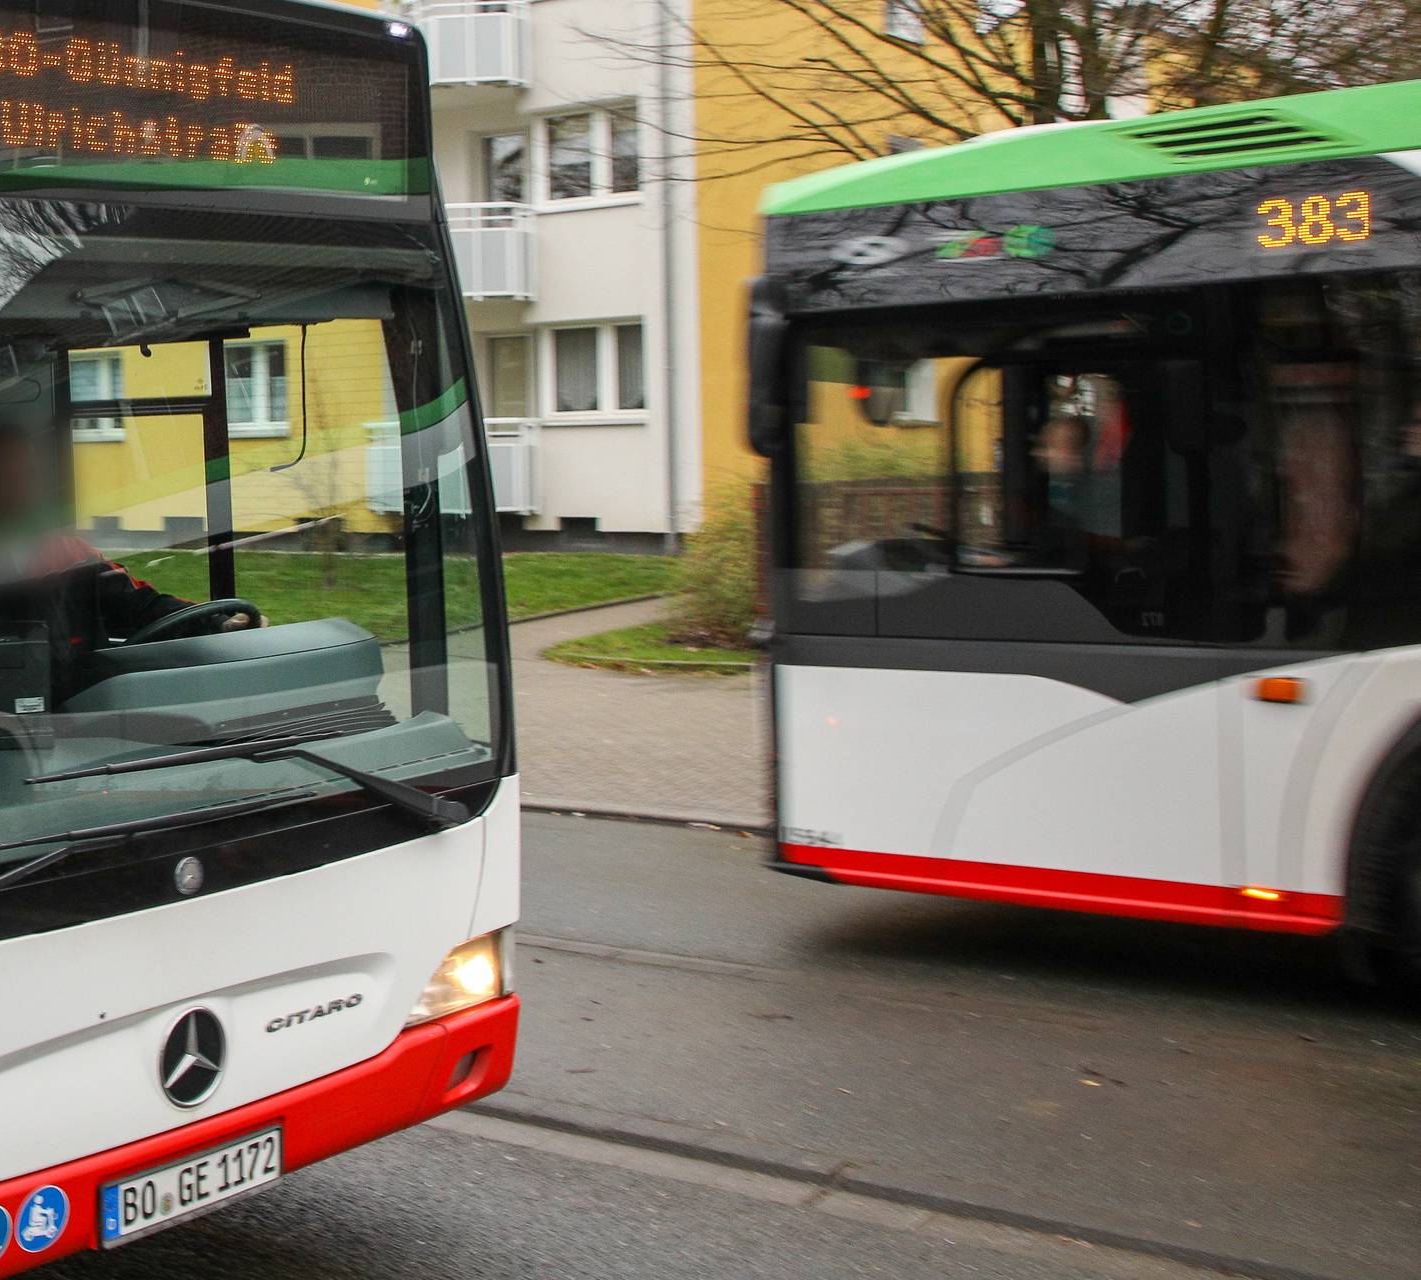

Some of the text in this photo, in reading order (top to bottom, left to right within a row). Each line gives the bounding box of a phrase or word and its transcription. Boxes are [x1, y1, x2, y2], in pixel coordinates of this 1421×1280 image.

[1256, 189, 1372, 249] 383
[265, 994, 364, 1033] CITARO
[123, 1136, 275, 1225] BO GE 1172
